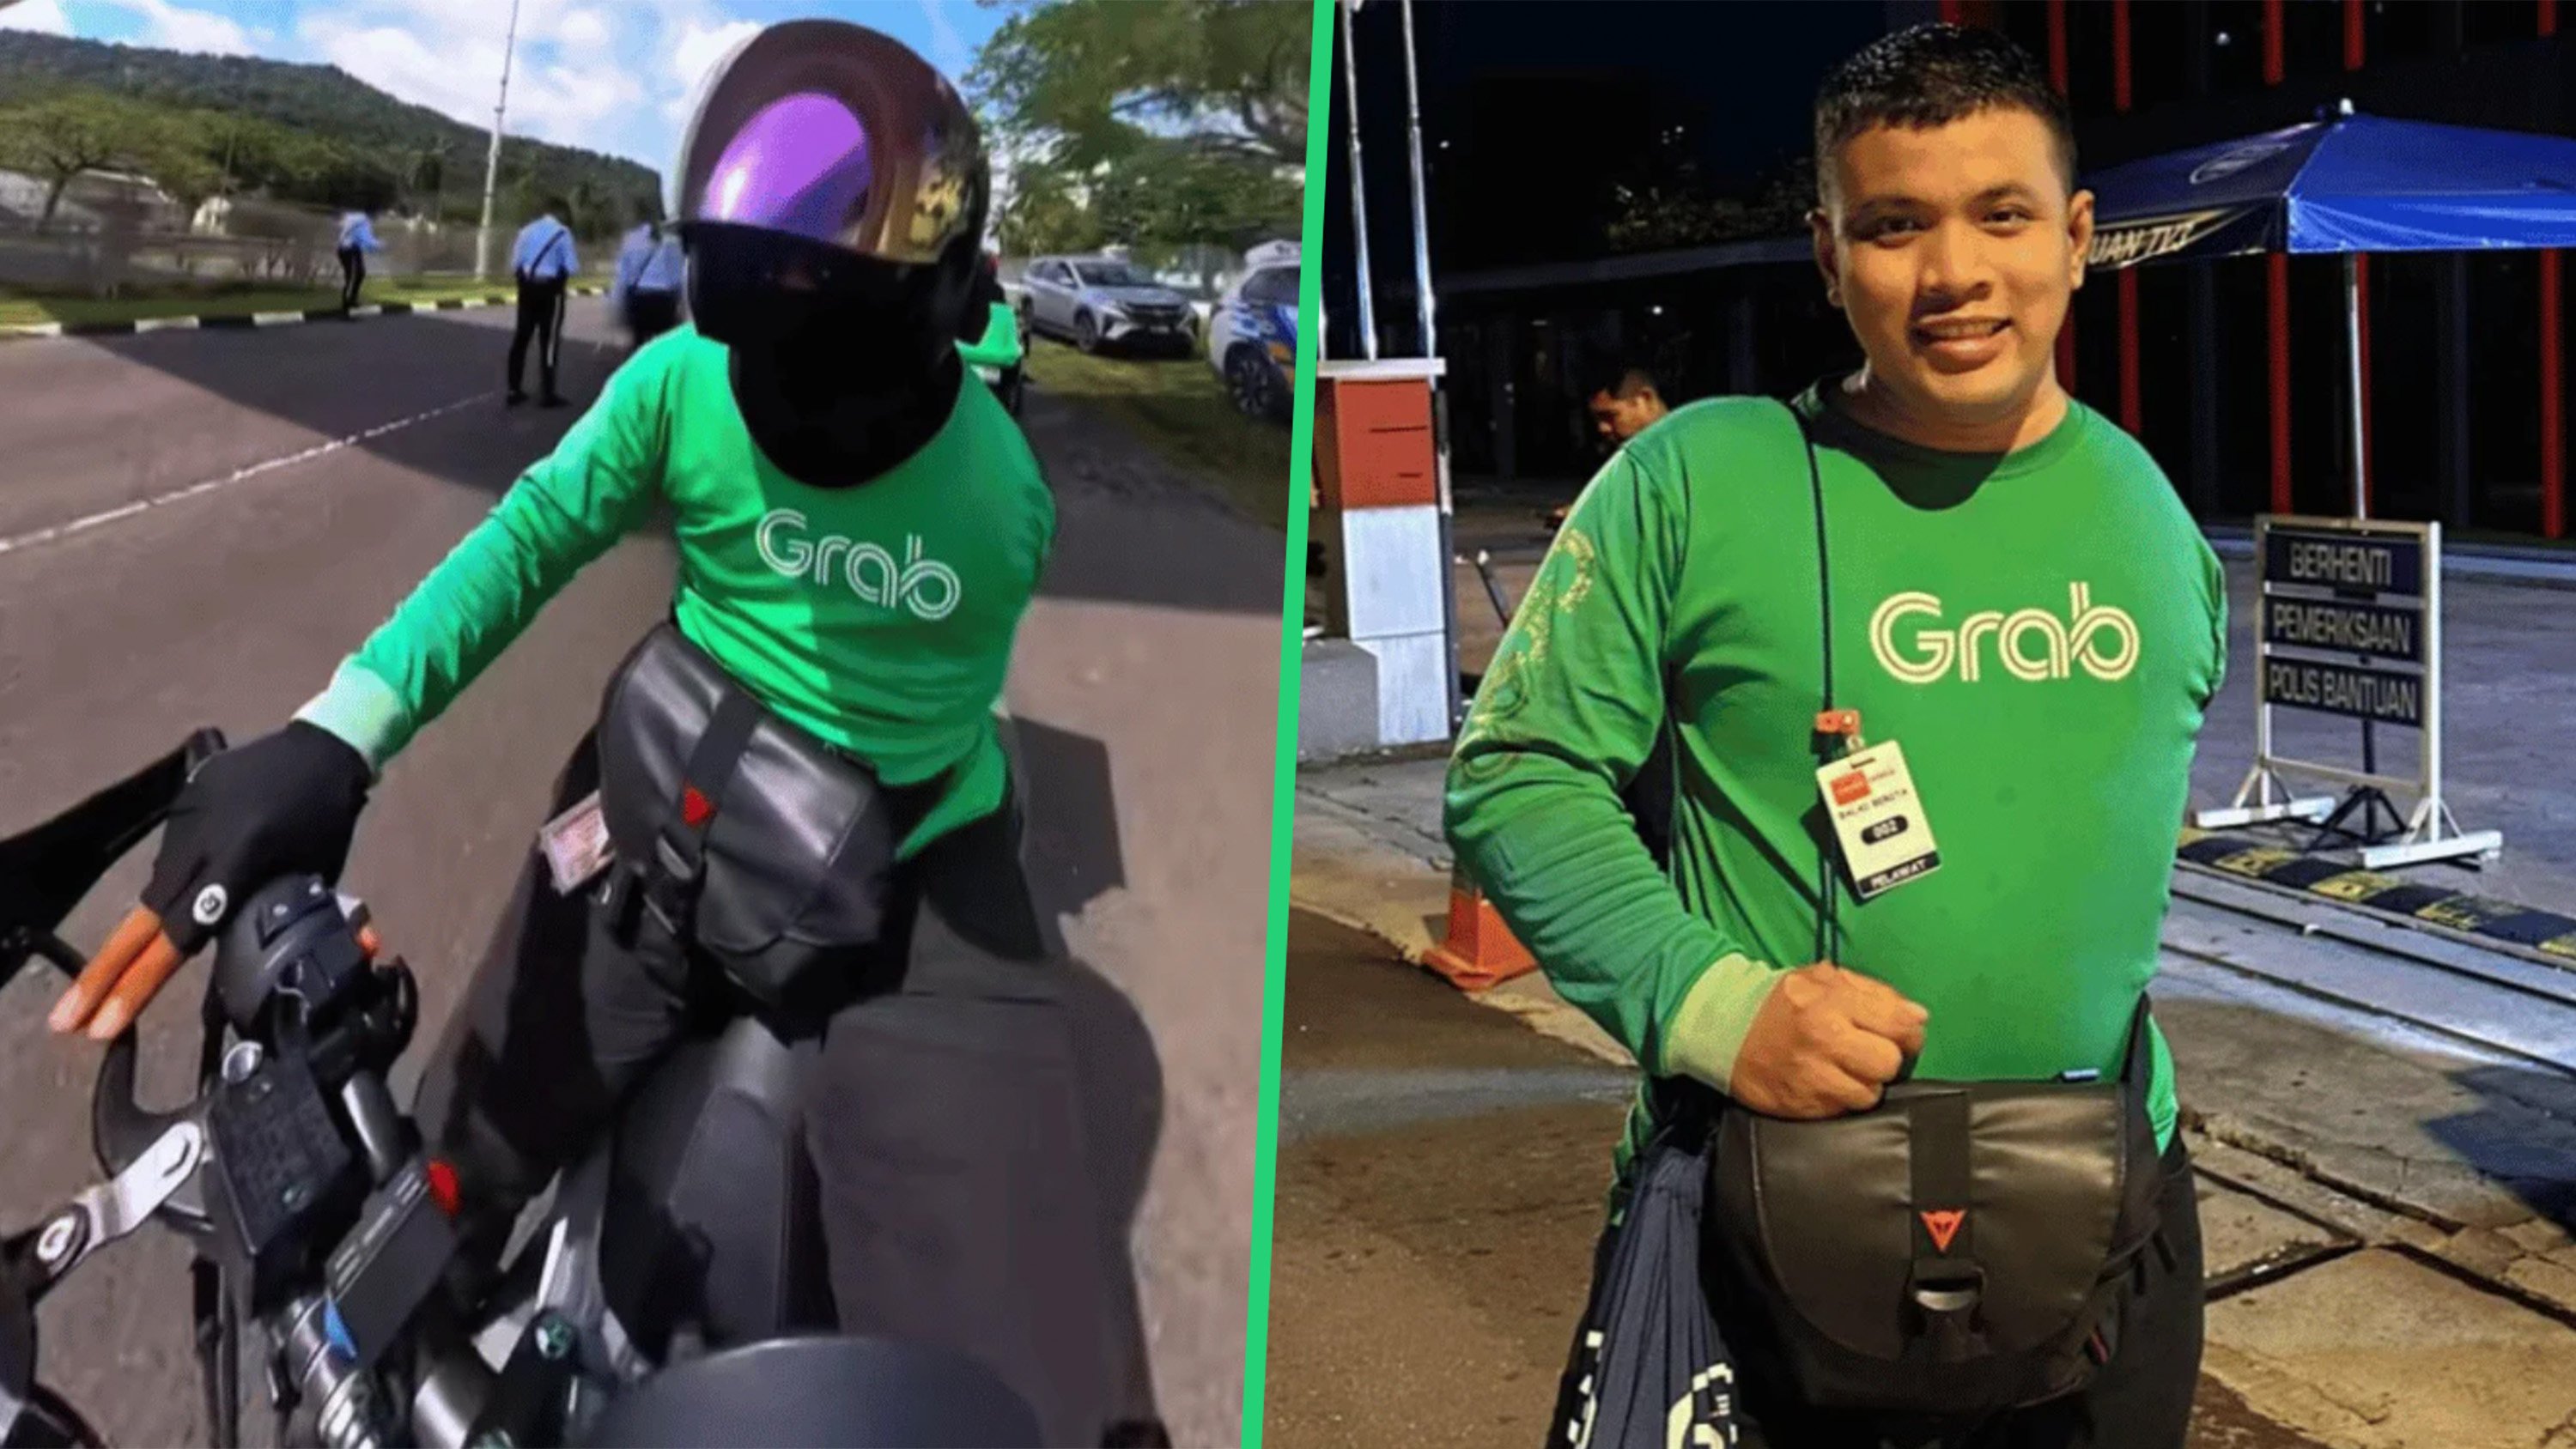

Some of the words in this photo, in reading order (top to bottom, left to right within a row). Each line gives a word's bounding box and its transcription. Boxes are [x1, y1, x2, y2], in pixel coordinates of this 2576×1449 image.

[755, 507, 962, 621] Grab
[2290, 543, 2392, 587] BERHENTI
[1869, 581, 2140, 684] Grab
[2273, 603, 2411, 654] PEMERIKSAAN
[2269, 664, 2318, 704] POLIS
[2323, 670, 2417, 720] BANTUAN
[1871, 860, 1926, 888] PELAWAT
